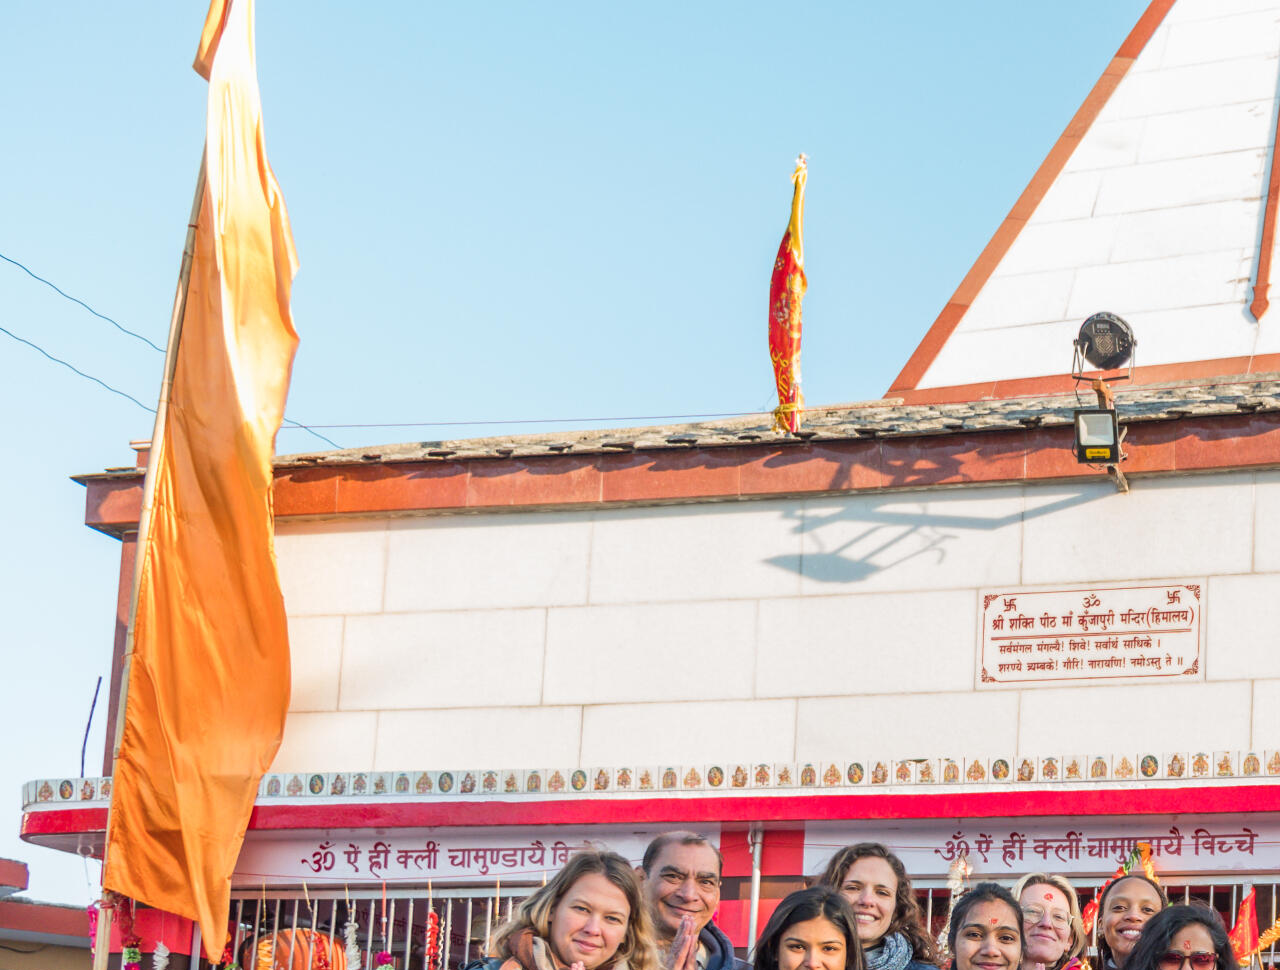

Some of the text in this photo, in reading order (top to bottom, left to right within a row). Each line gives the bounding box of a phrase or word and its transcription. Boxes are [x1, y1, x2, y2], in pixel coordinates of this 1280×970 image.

[992, 614, 1004, 631] श्री
[1008, 614, 1034, 631] शक्ति
[1039, 612, 1056, 629] पीठ
[343, 843, 362, 873] ऐं
[447, 840, 547, 876] चामुण्डायै
[974, 833, 994, 863] ऐं
[1191, 827, 1260, 856] विच्चे
